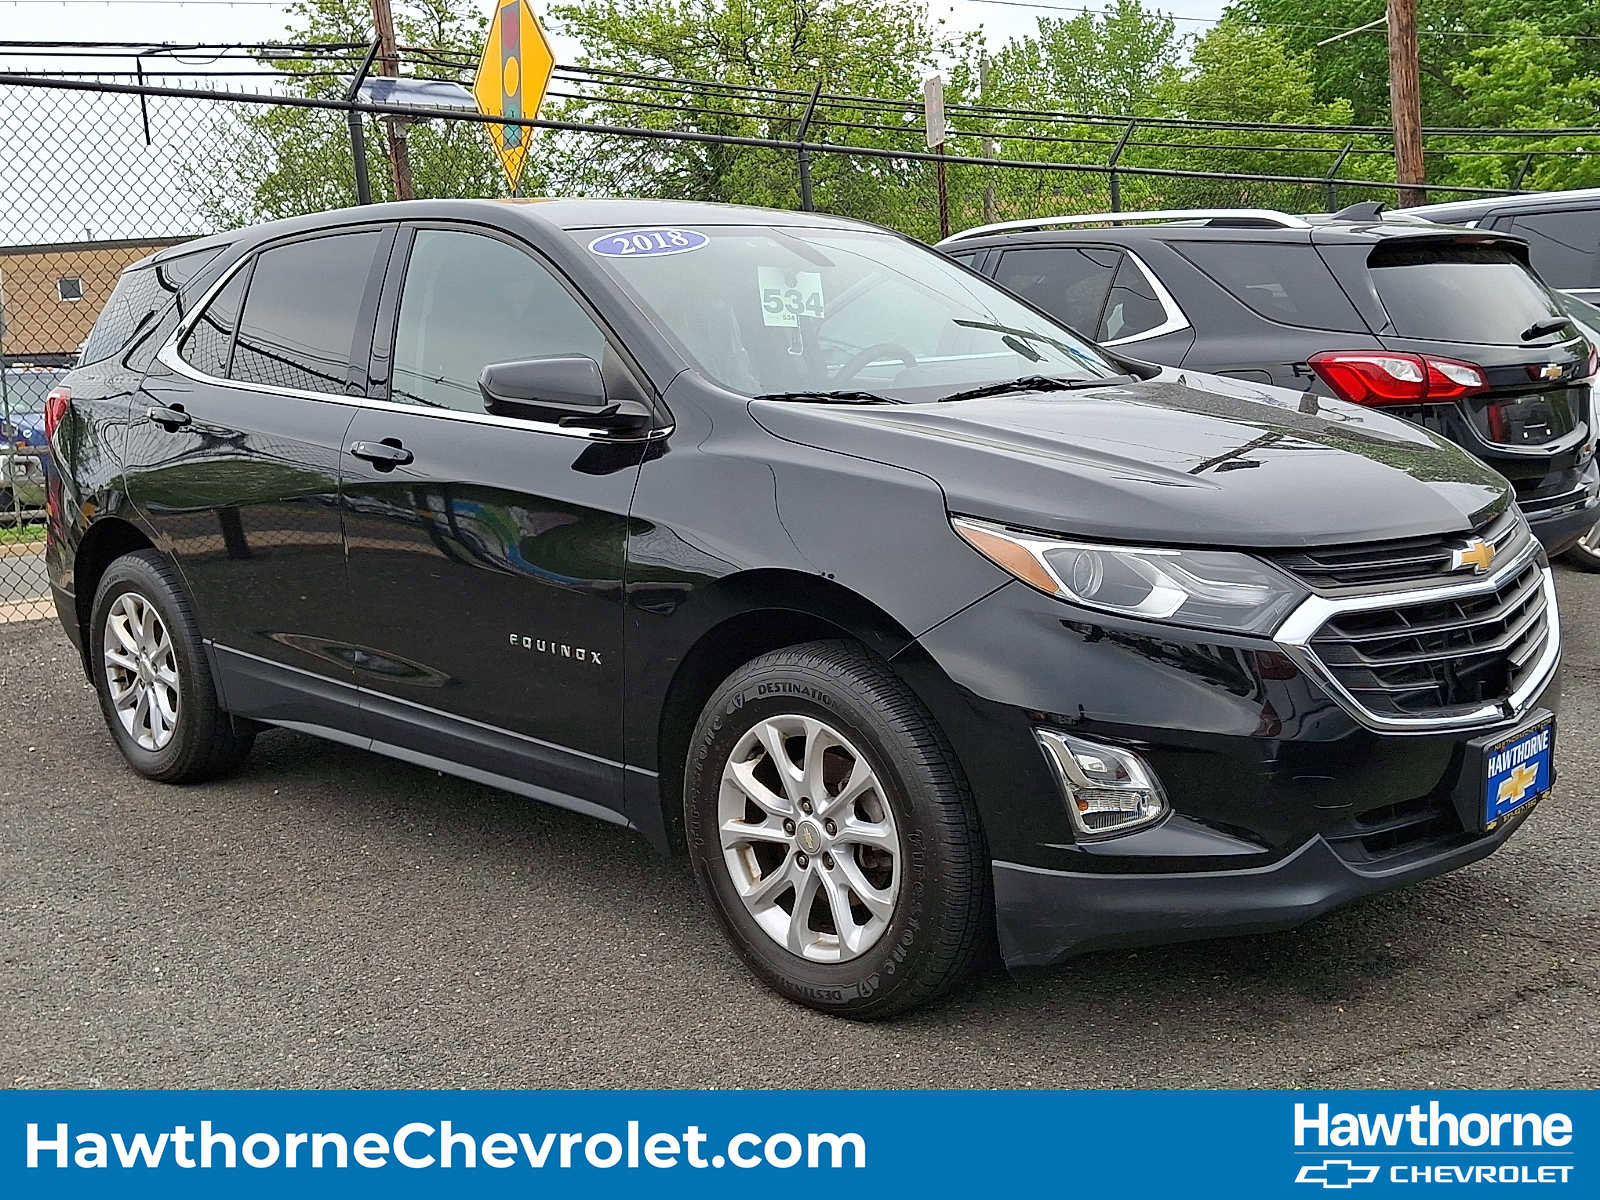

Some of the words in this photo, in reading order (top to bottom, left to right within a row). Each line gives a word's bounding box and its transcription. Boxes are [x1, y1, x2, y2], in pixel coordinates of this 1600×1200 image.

[613, 229, 689, 255] 2018
[763, 288, 824, 317] 534
[509, 633, 602, 665] EQUINOX
[1487, 729, 1549, 779] HAWTHORNE
